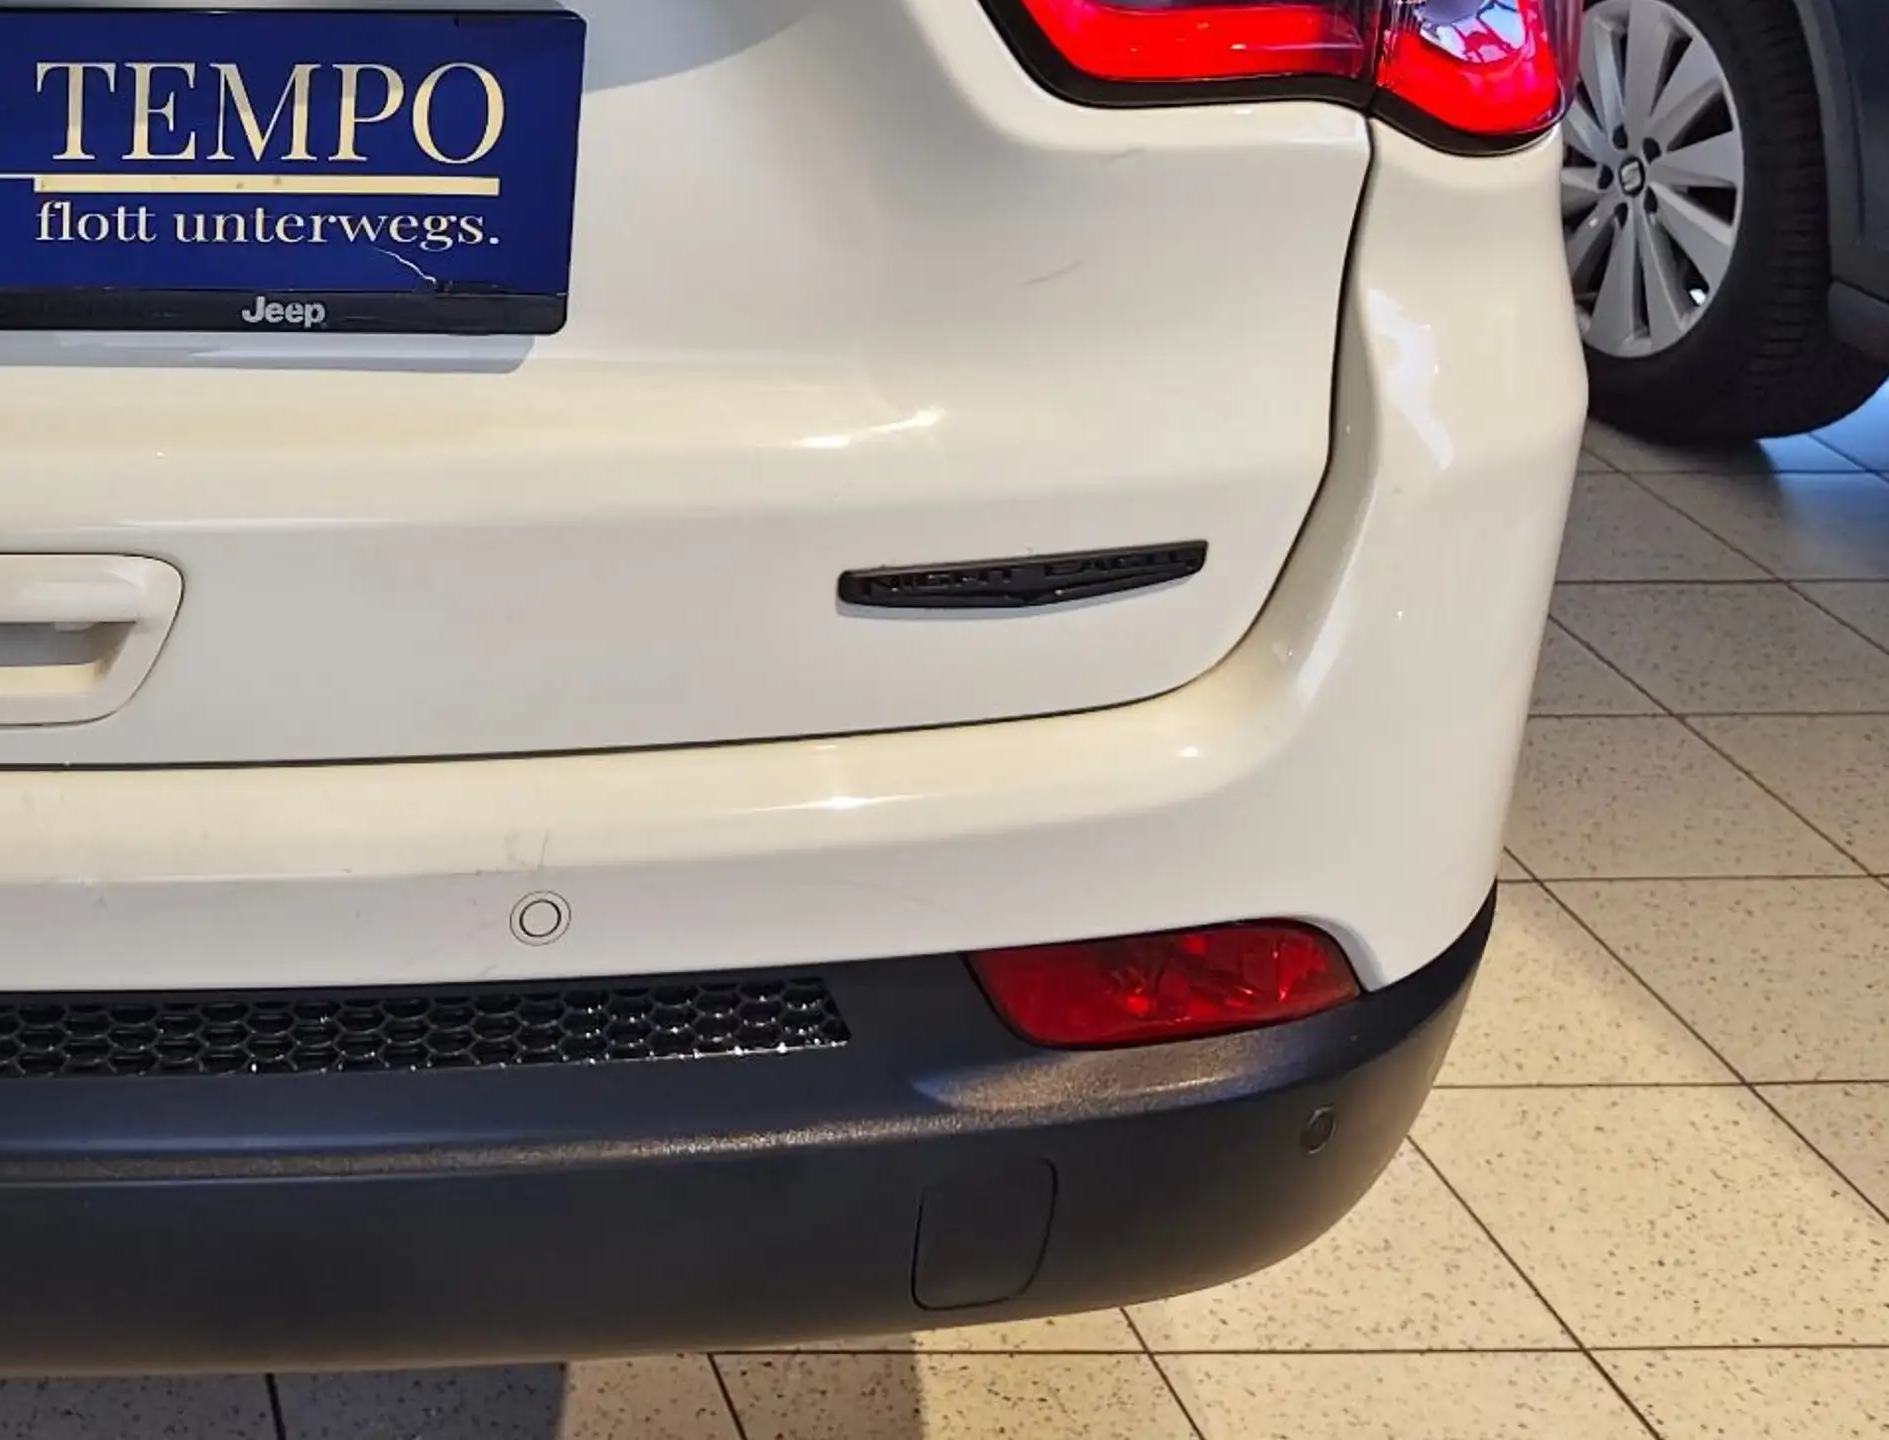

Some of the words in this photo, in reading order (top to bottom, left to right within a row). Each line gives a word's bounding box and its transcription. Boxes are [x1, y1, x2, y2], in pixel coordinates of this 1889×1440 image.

[36, 61, 506, 164] TEMPO
[35, 200, 158, 243] flott
[172, 206, 500, 252] unterwegs.
[240, 295, 327, 328] Jeep
